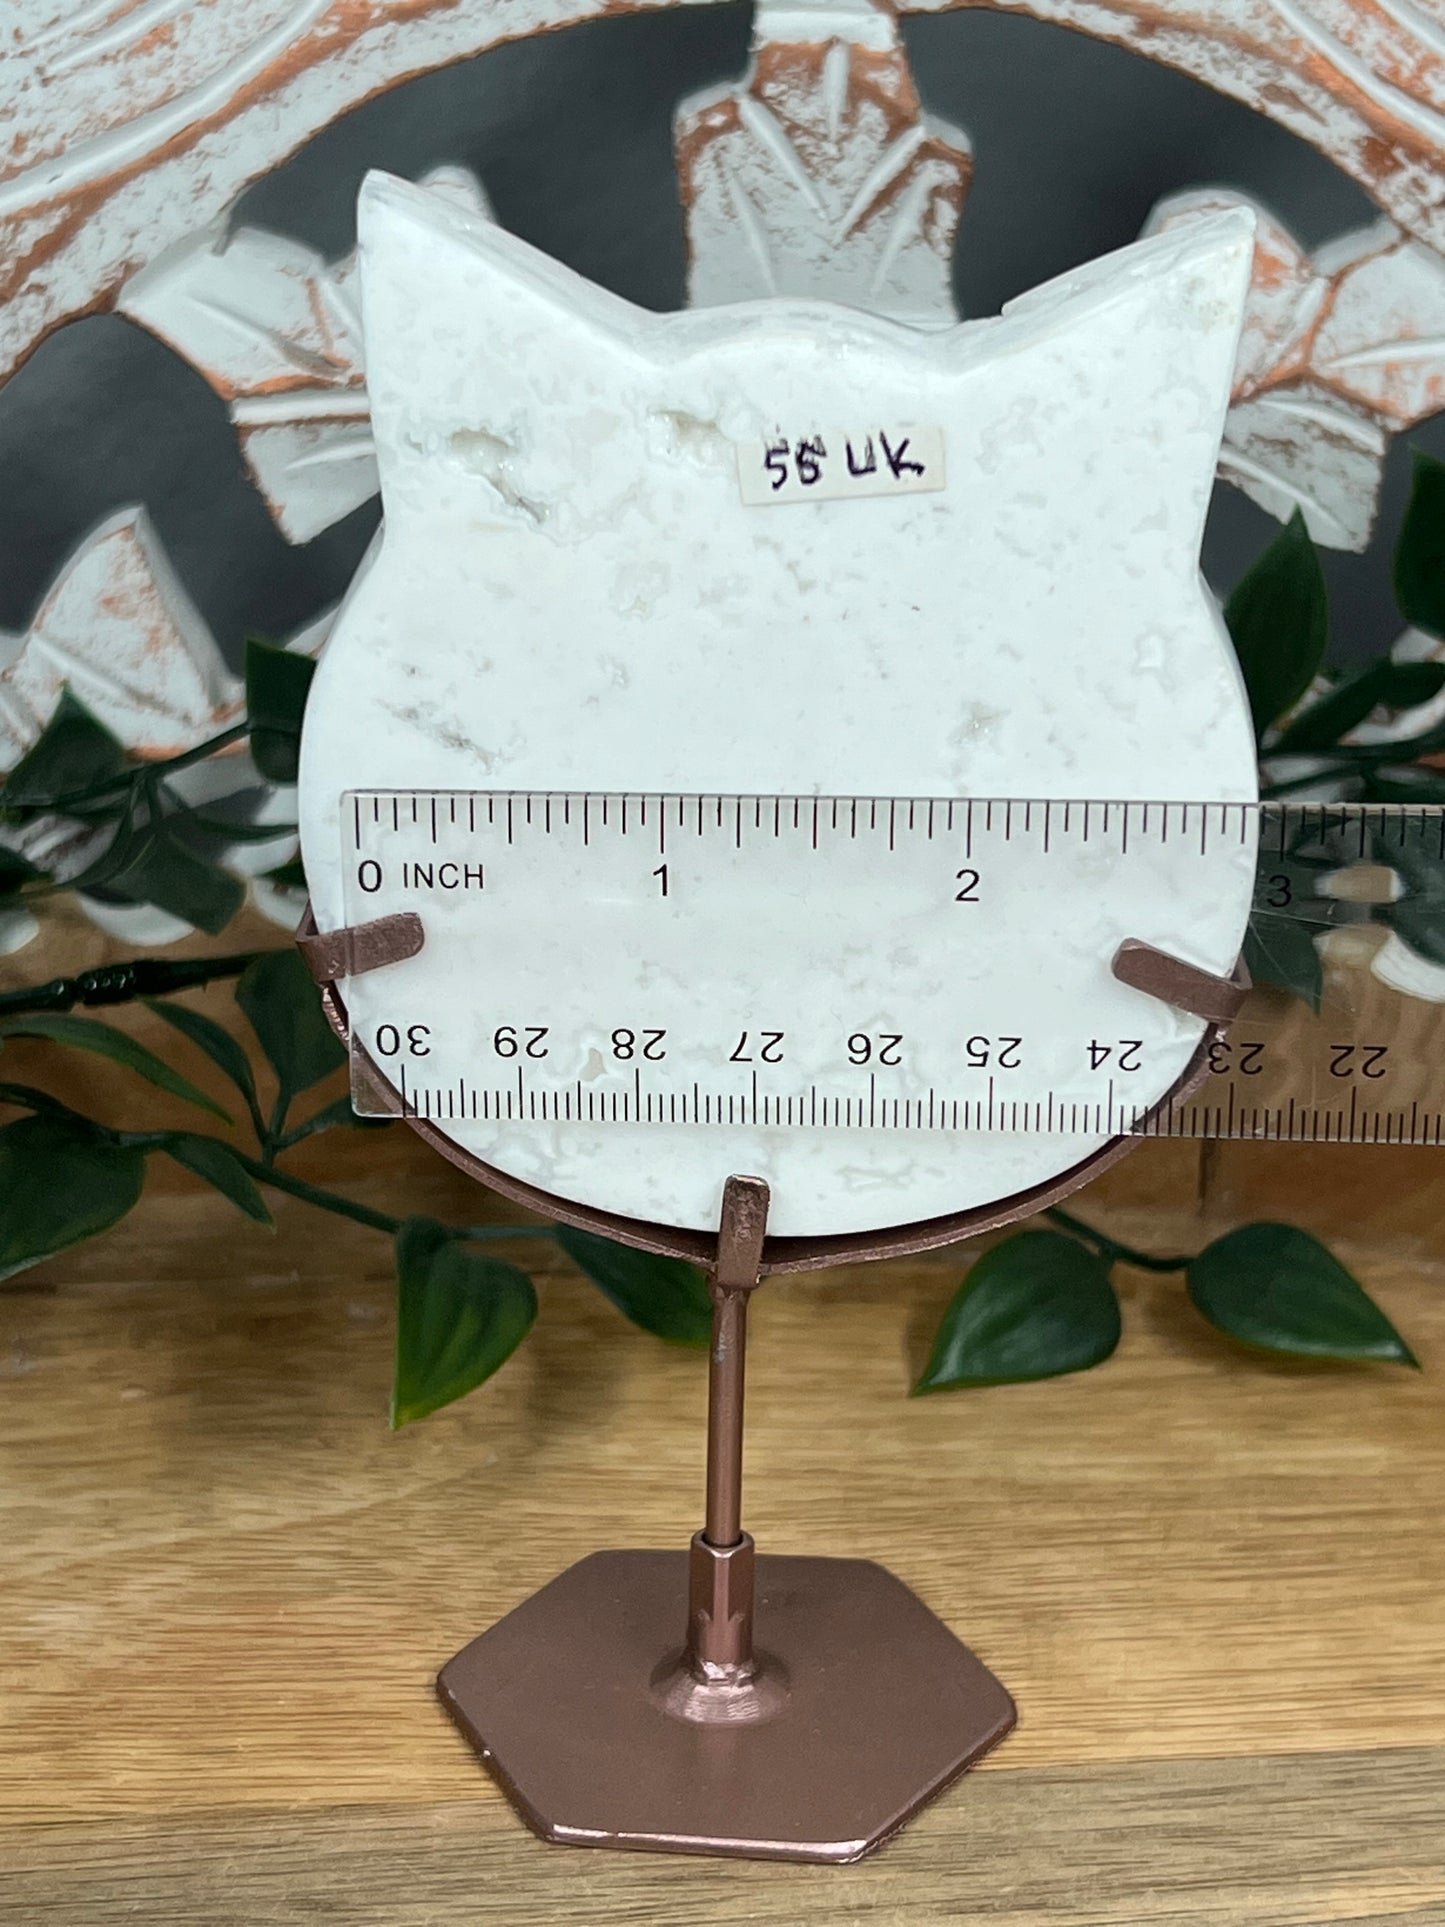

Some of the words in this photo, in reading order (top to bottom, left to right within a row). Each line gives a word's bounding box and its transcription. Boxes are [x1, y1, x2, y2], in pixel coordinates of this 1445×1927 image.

[845, 430, 925, 479] UK
[357, 859, 383, 893] 0
[402, 862, 485, 890] INCH
[652, 863, 668, 897] 1
[954, 868, 981, 902] 2
[1267, 874, 1292, 908] 3
[375, 1024, 431, 1057] 30
[493, 1026, 549, 1059] 29
[611, 1028, 667, 1061] 28
[729, 1031, 785, 1063] 27
[847, 1033, 903, 1066] 26
[965, 1036, 1022, 1069] 25
[1086, 1039, 1143, 1072] 24
[1208, 1041, 1265, 1076] 23
[1329, 1044, 1388, 1079] 22
